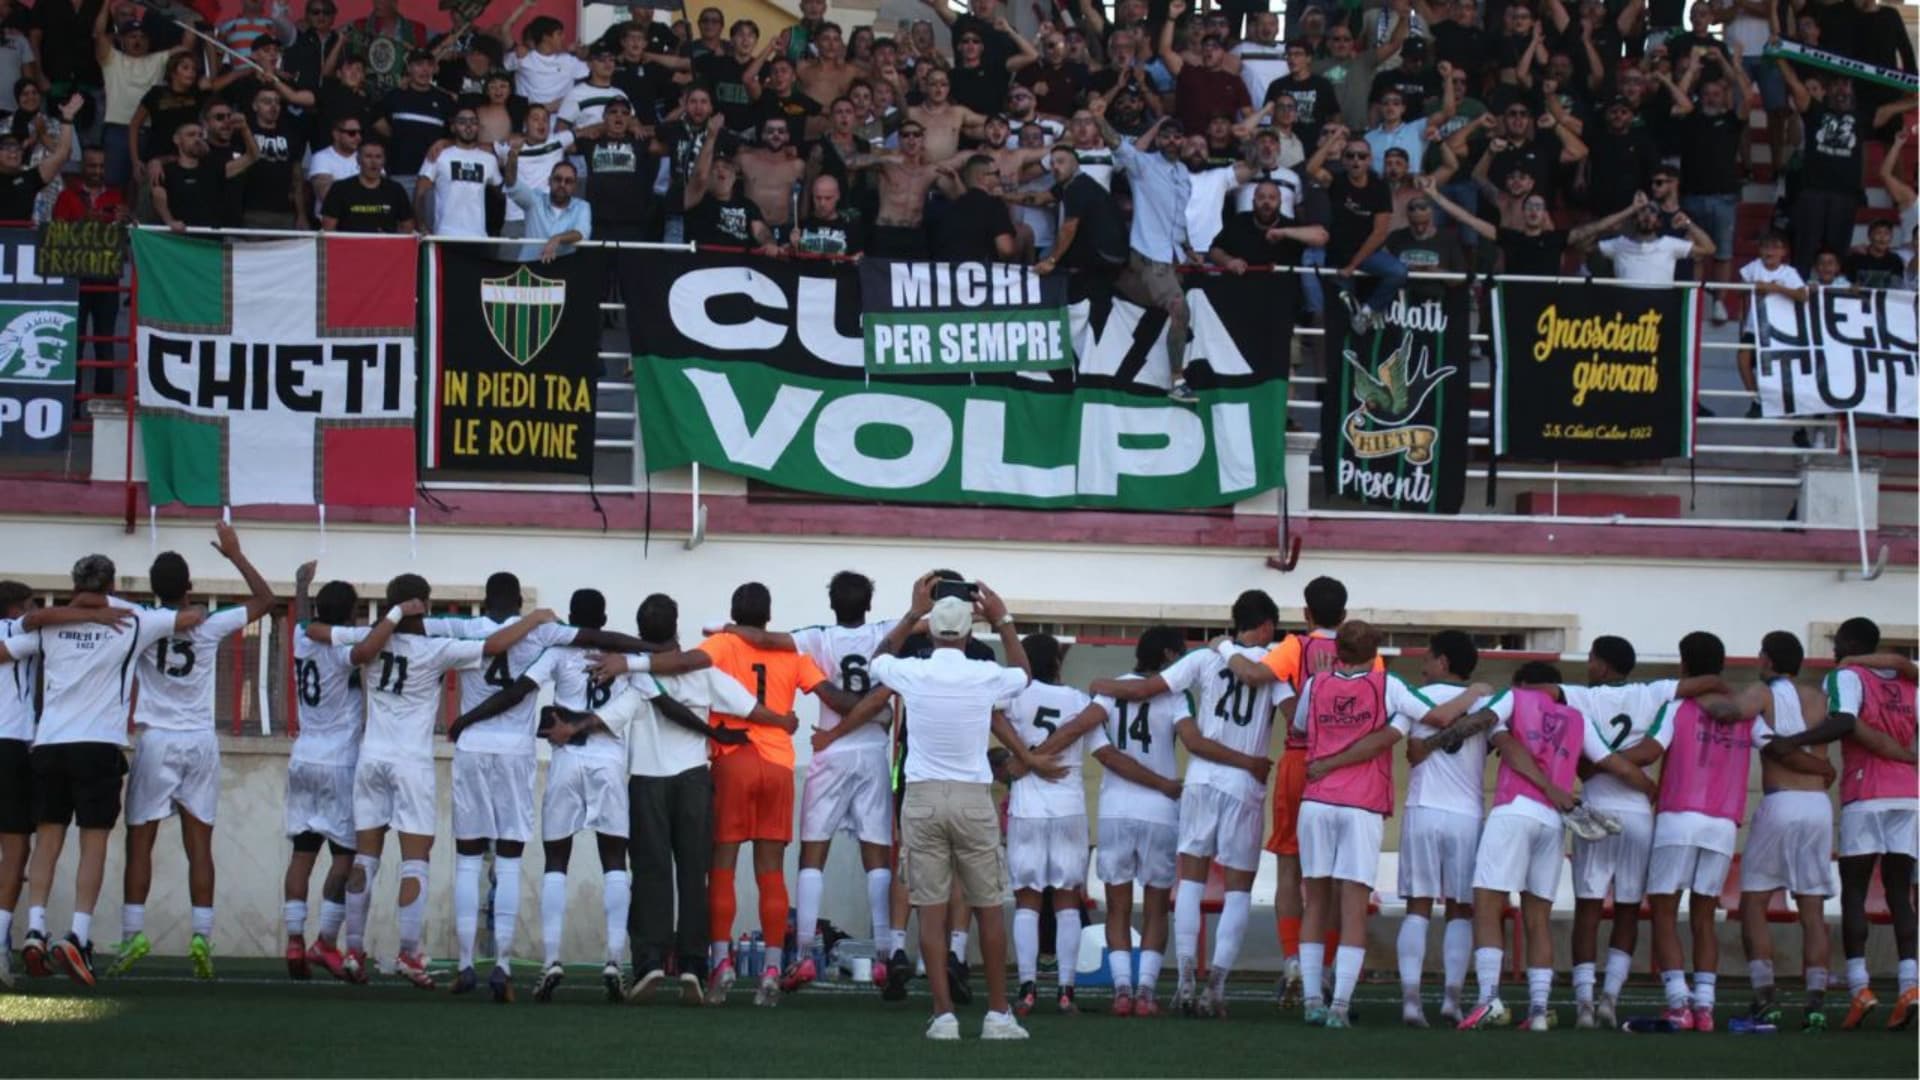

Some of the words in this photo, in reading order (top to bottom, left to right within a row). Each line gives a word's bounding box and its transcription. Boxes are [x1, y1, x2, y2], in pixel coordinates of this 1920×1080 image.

[890, 261, 1041, 307] MICHI
[668, 266, 1254, 389] CUVA
[874, 324, 932, 364] PER
[939, 320, 1064, 364] SEMPRE
[1533, 304, 1662, 362] Incoscienti
[147, 334, 400, 413] CHIETI
[444, 370, 468, 406] IN
[477, 371, 536, 409] PIEDI
[544, 374, 591, 413] TRA
[1572, 352, 1658, 407] giovani
[453, 418, 480, 455] LE
[489, 420, 578, 460] ROVINE
[683, 368, 1256, 497] VOLPI
[1338, 458, 1434, 503] Presenti
[484, 650, 515, 690] 4
[751, 663, 767, 706] 1
[839, 654, 871, 695] 6
[1215, 667, 1257, 727] 20
[1030, 706, 1061, 751] 5
[1114, 698, 1152, 753] 14
[1609, 713, 1633, 753] 2
